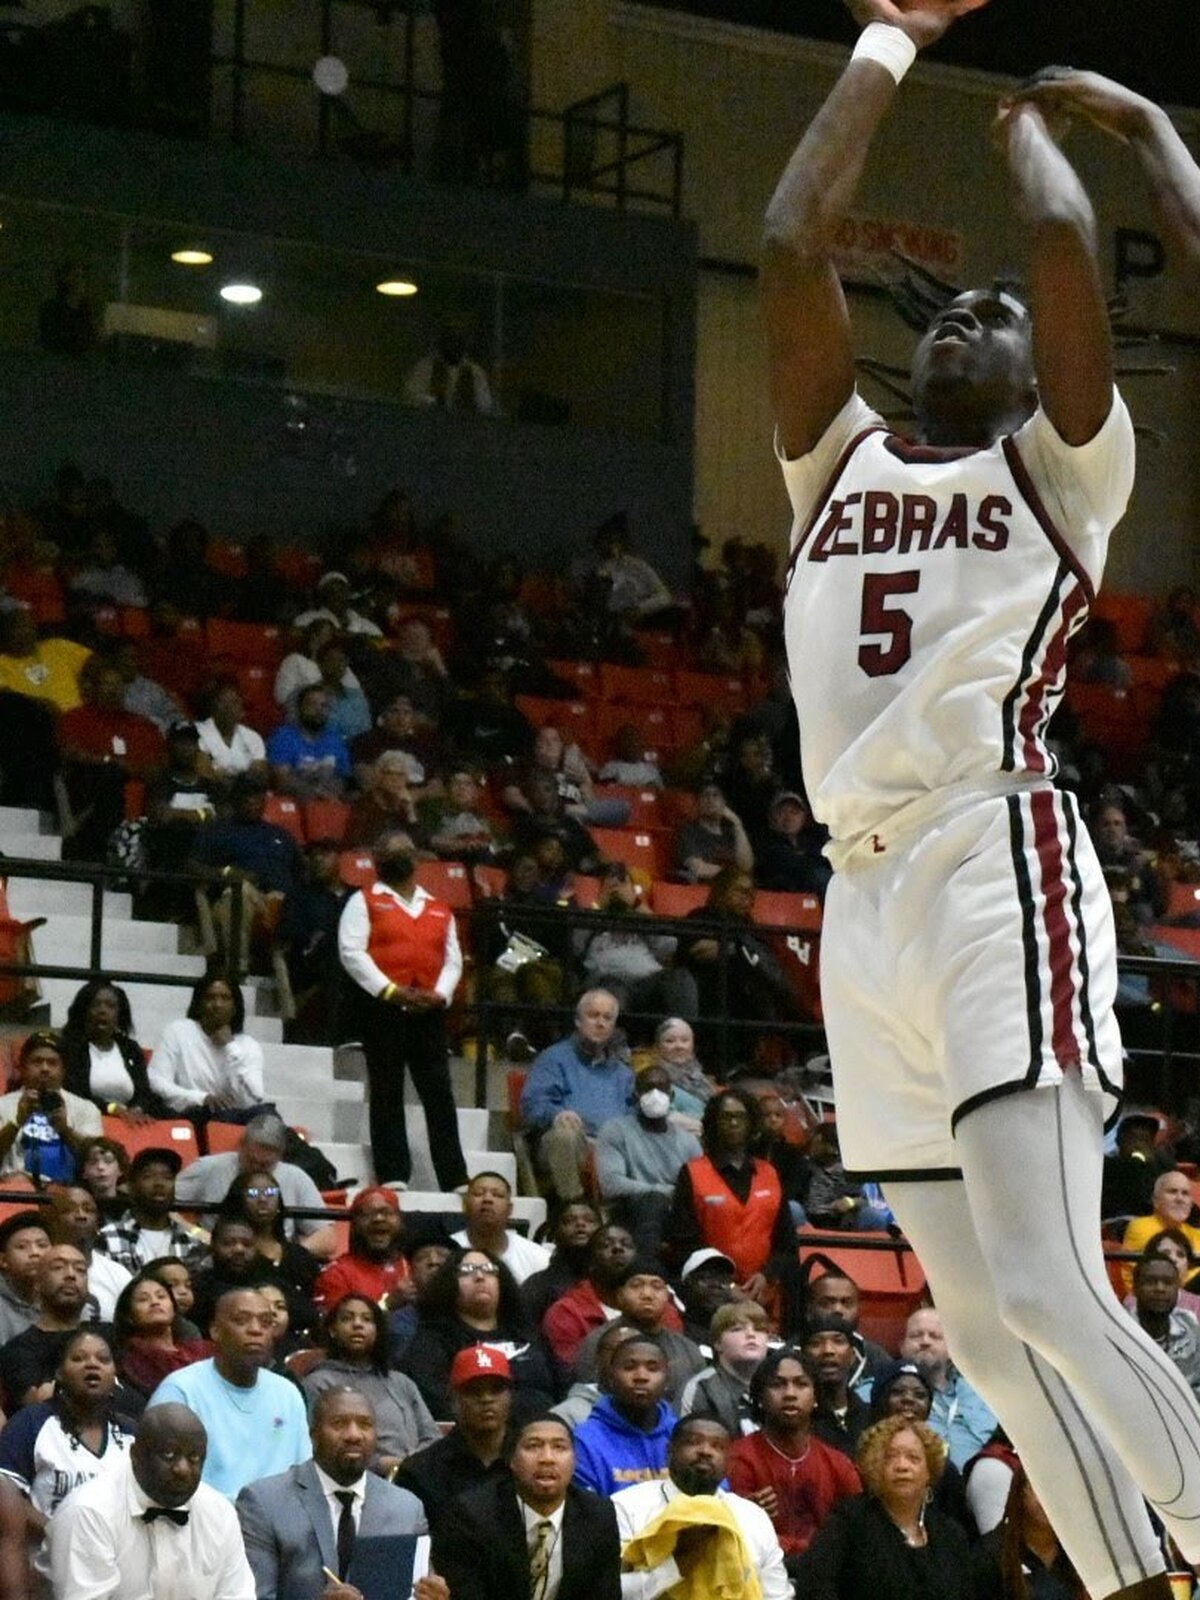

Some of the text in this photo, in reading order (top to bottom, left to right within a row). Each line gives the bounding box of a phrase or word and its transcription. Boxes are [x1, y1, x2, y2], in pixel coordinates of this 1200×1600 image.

[1114, 226, 1165, 296] P
[808, 491, 1012, 562] ZEBRAS
[857, 569, 920, 677] 5
[475, 1349, 493, 1368] LA
